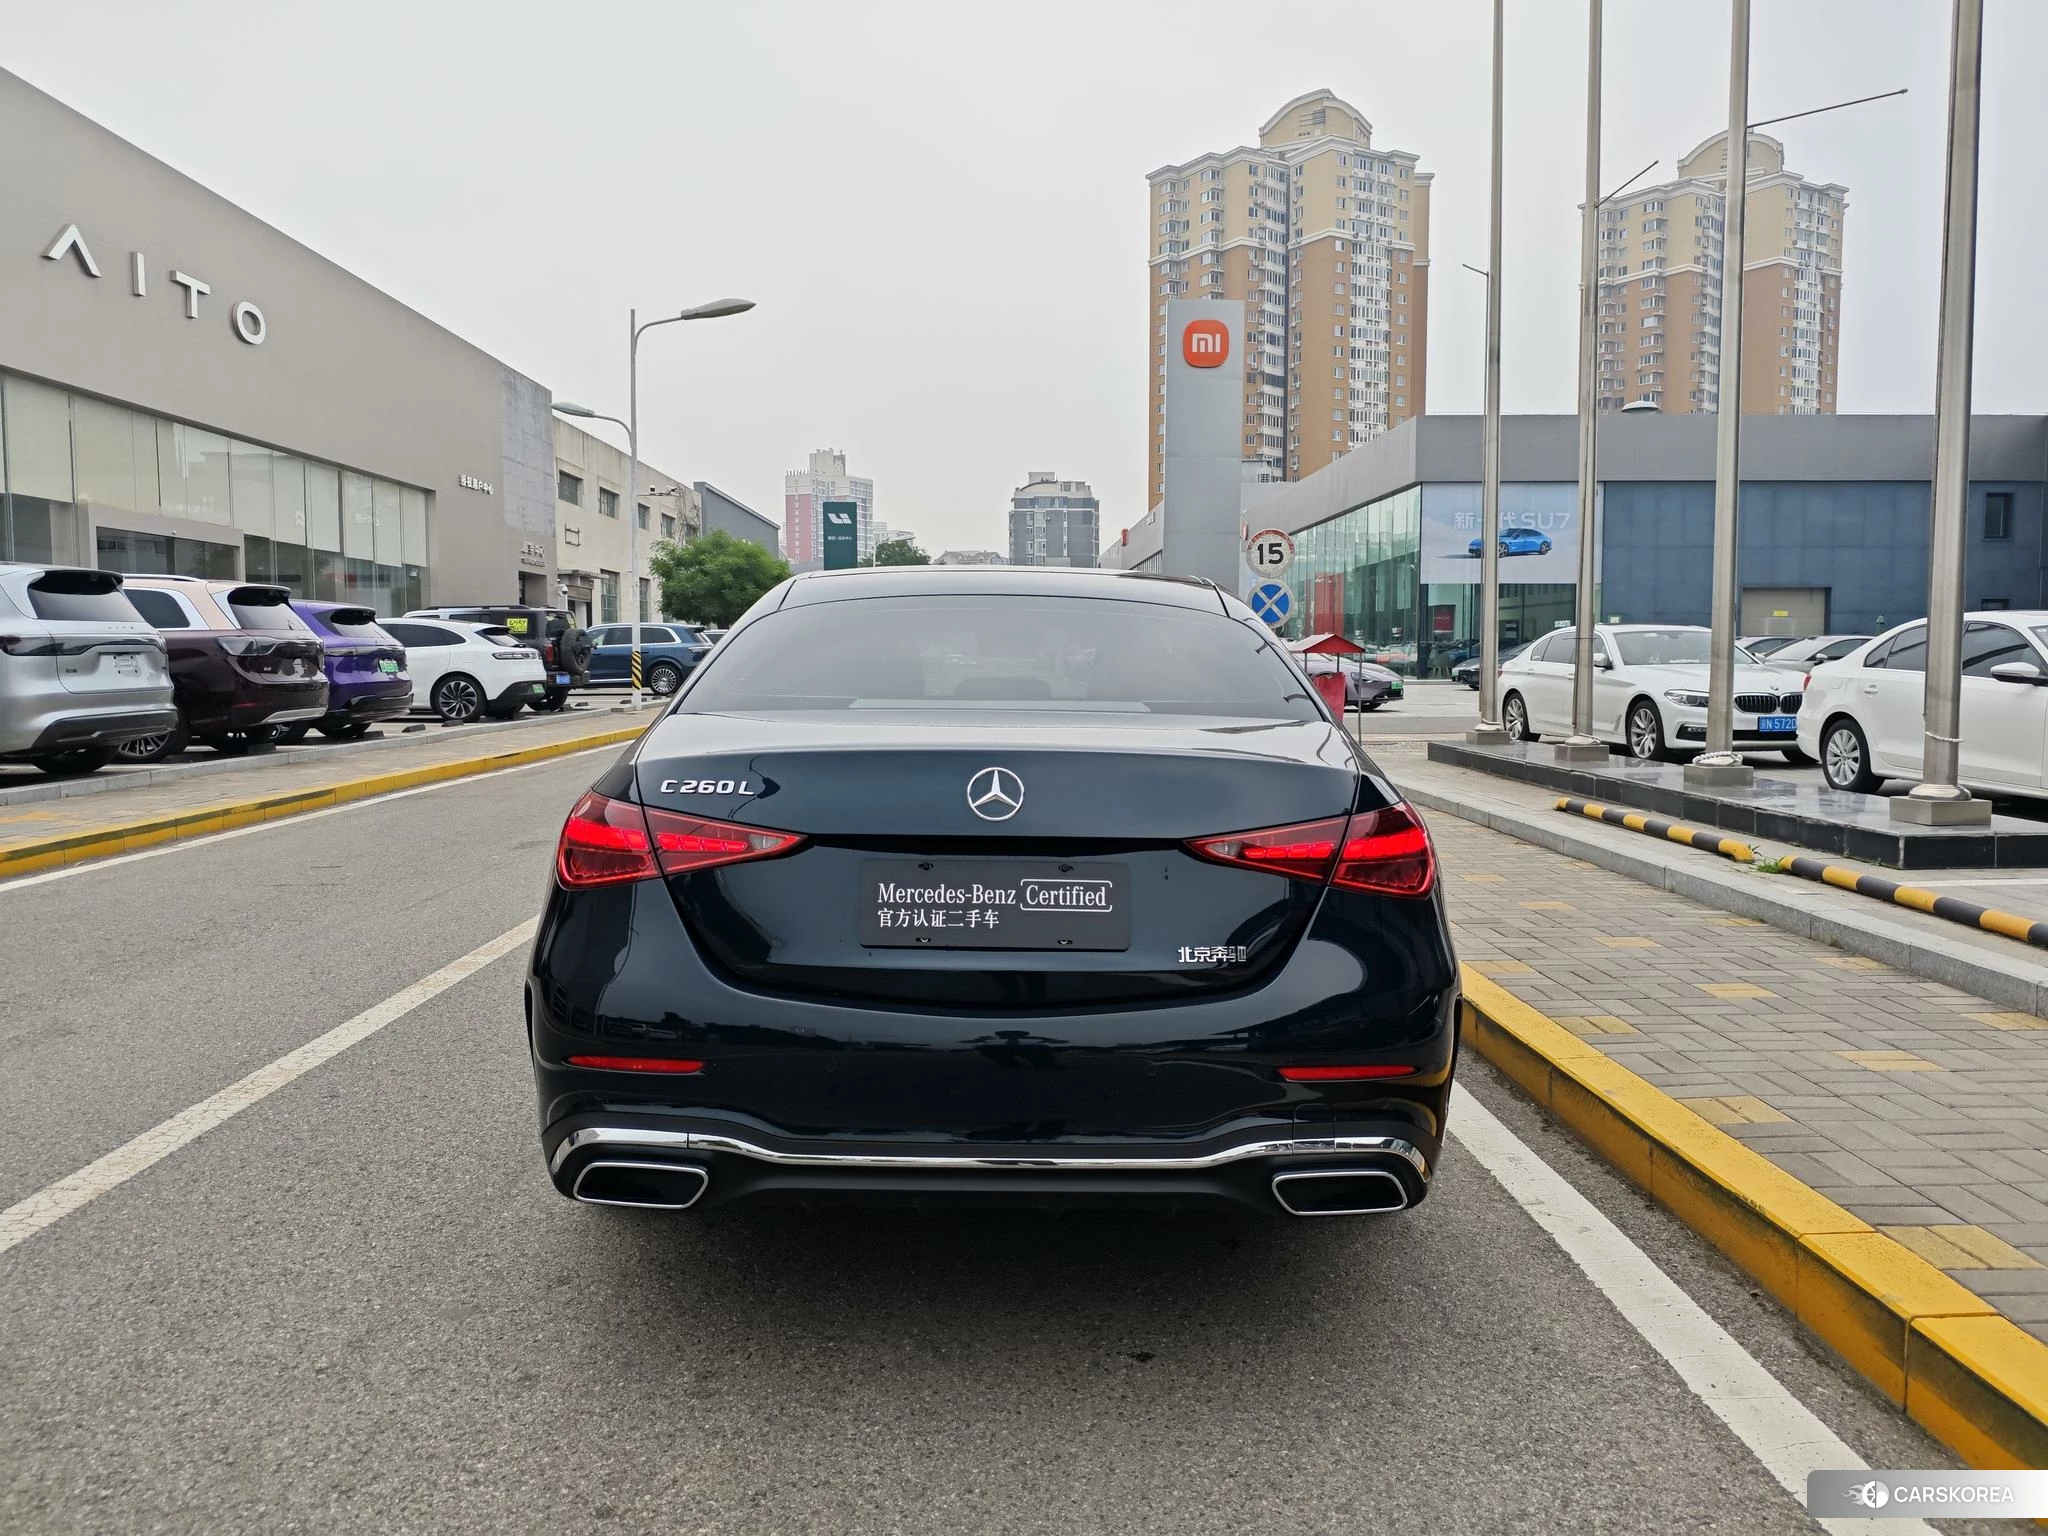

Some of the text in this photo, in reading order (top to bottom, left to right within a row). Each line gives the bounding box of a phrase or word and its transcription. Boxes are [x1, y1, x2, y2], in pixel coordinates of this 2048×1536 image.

[41, 223, 266, 345] AITO
[1520, 511, 1571, 530] SU7
[1257, 543, 1284, 565] 15
[660, 779, 755, 796] C 260 L
[877, 882, 1107, 906] Mercedes-Benz Certified
[877, 907, 1000, 929] 官方认证二手车
[1177, 945, 1247, 963] 北京奔驰
